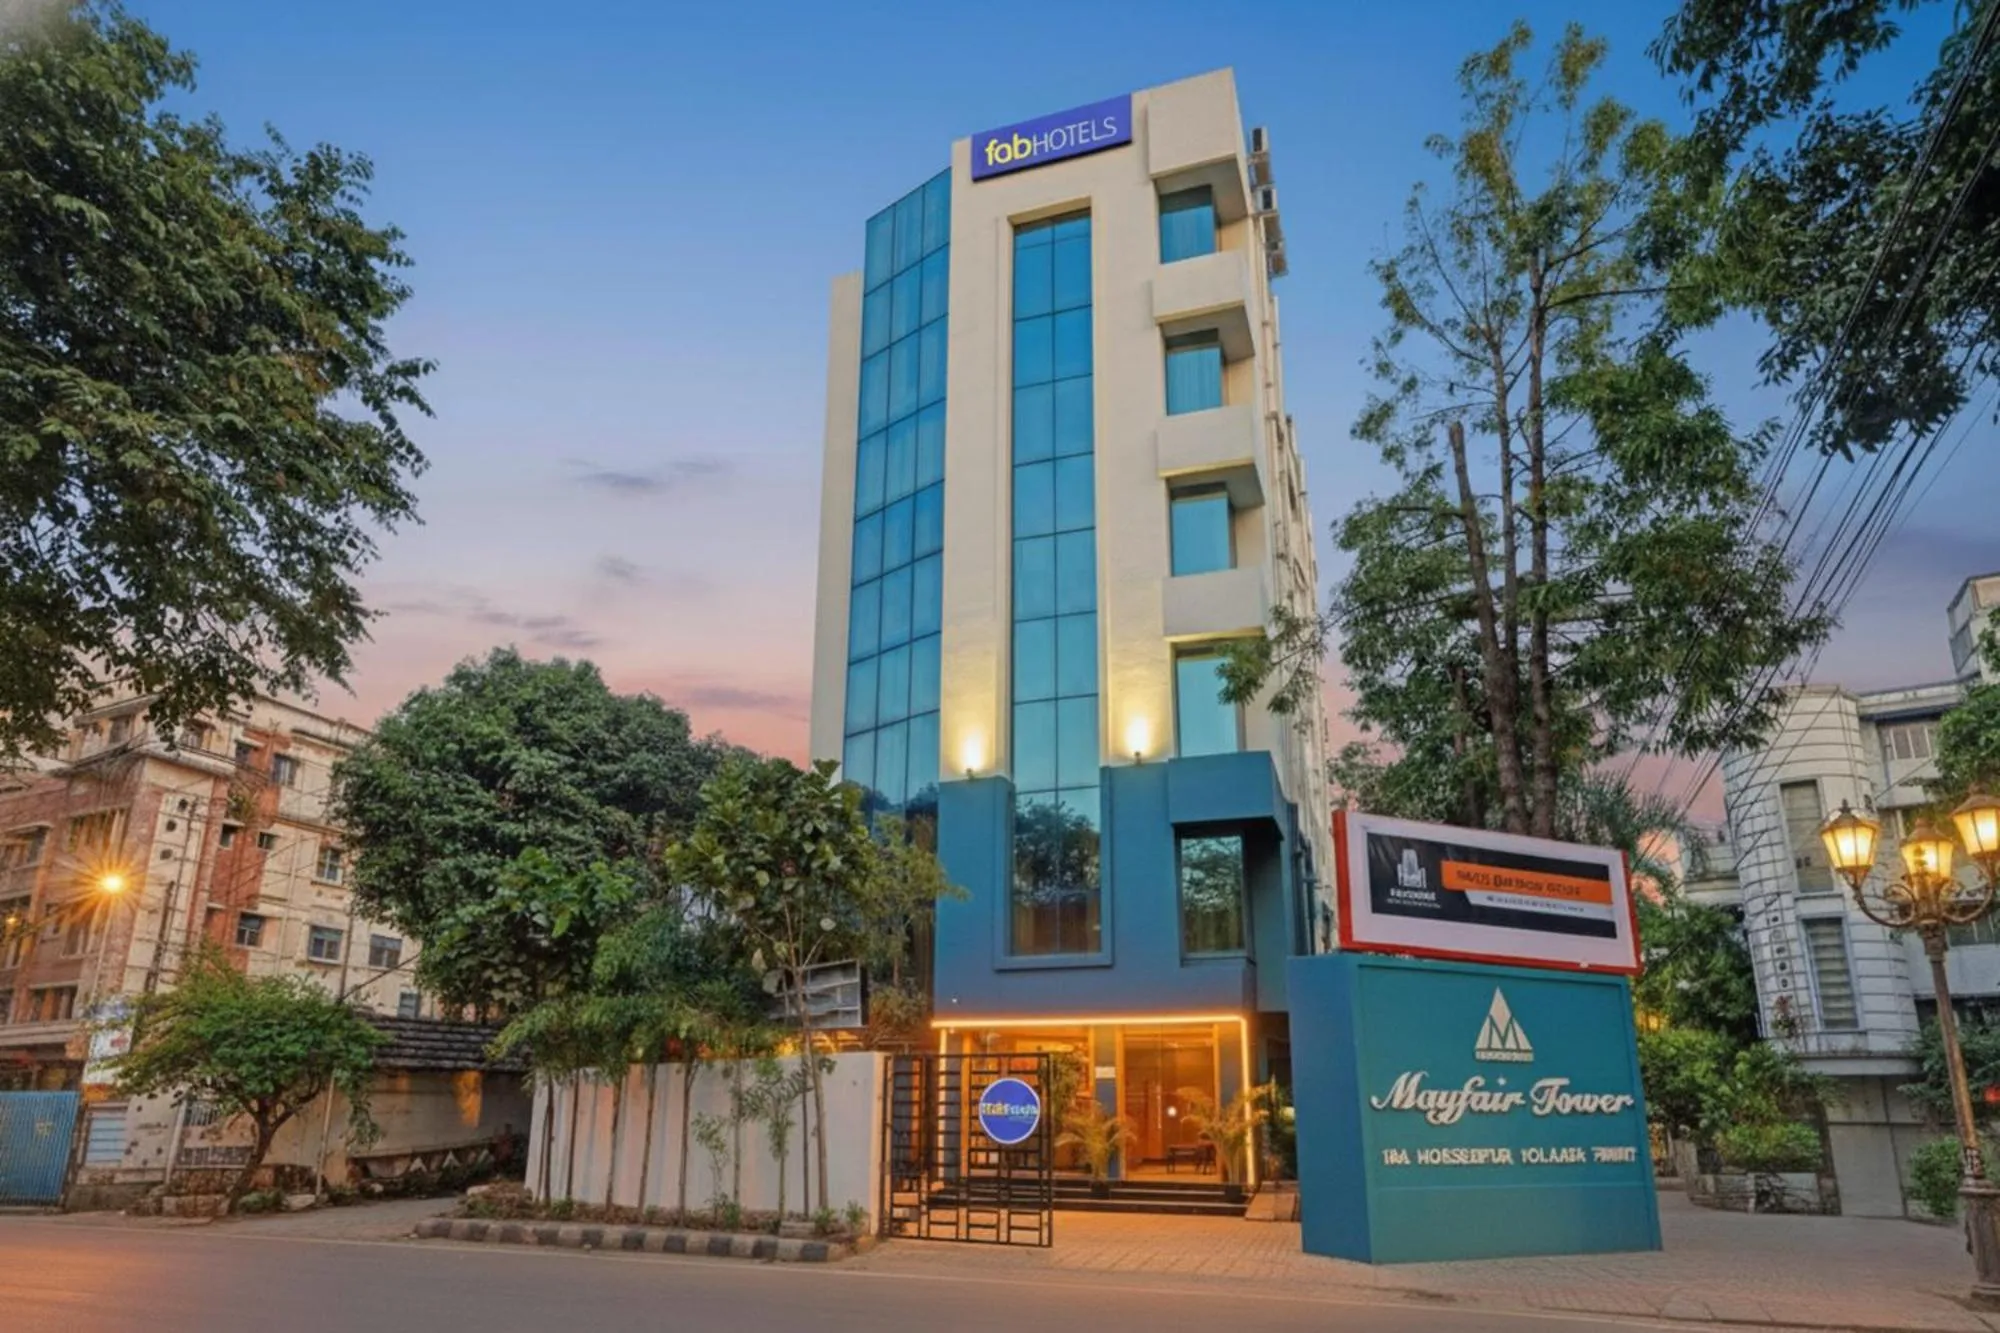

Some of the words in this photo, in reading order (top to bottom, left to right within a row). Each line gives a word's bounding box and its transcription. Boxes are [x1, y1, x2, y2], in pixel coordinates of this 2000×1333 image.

[984, 116, 1119, 167] fabHOTELS
[1370, 1070, 1526, 1125] Mayfair
[1528, 1077, 1635, 1116] Tower
